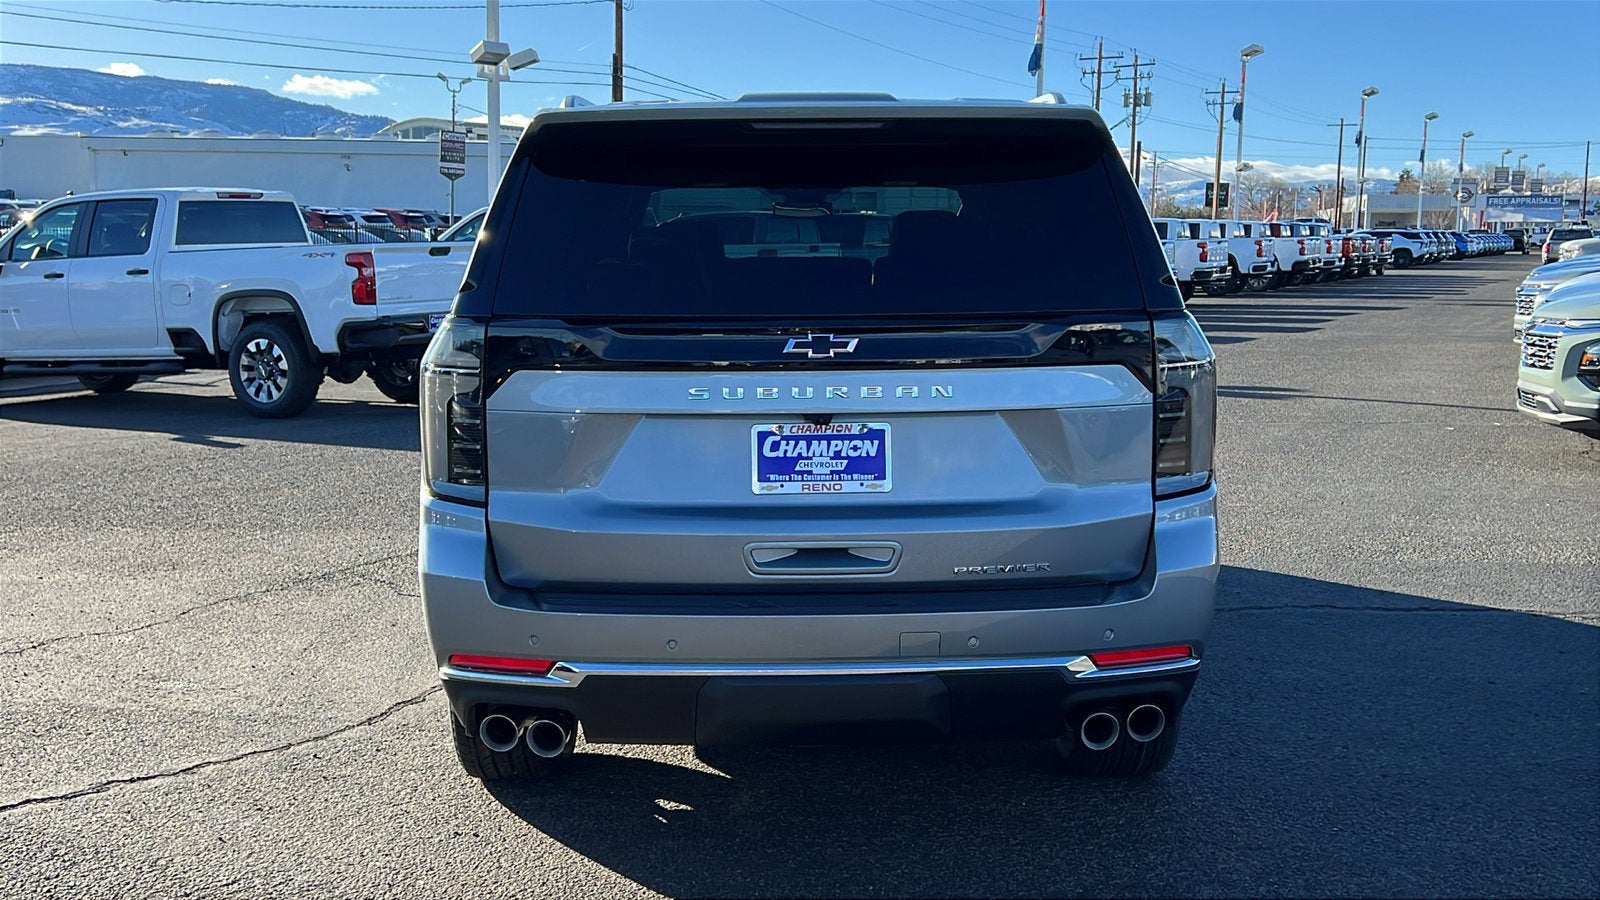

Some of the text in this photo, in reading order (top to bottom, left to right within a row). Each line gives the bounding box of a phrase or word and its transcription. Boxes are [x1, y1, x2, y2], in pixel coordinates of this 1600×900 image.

[1488, 197, 1561, 205] FREE APPRAISALS!
[687, 385, 954, 401] SUBURBAN
[789, 424, 853, 435] CHAMPION
[762, 436, 880, 458] CHAMPION
[798, 460, 845, 469] CHEVROLET
[791, 473, 802, 481] The
[803, 473, 832, 481] Customer
[833, 473, 839, 481] Is
[841, 473, 852, 481] The
[801, 483, 843, 492] RENO
[951, 562, 1052, 576] PREMIER
